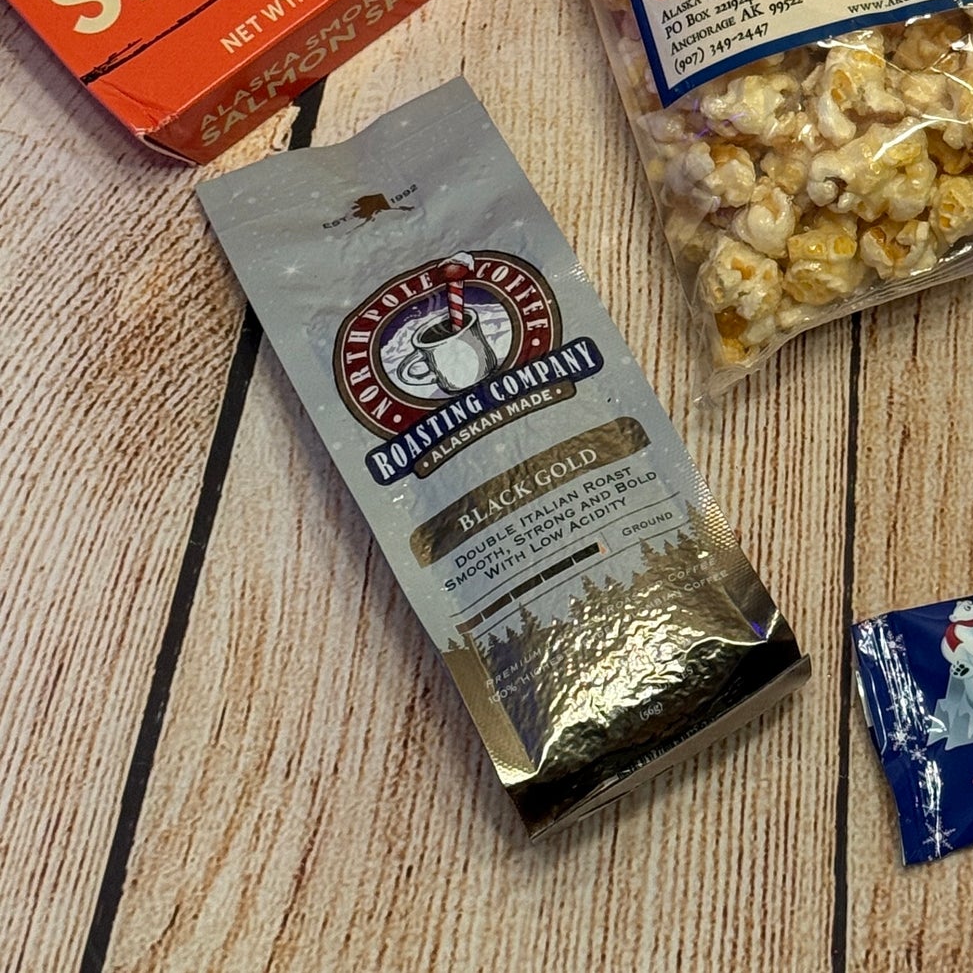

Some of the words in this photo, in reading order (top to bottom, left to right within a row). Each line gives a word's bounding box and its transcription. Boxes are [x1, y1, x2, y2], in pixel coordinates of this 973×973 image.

[219, 16, 264, 54] NET
[665, 21, 682, 39] PO
[670, 17, 736, 56] ANCHORAGE
[740, 3, 765, 22] AK
[674, 47, 705, 75] (907)
[710, 22, 769, 57] 349-2447
[201, 51, 301, 129] ALASKA
[202, 25, 357, 147] SALMON
[362, 272, 433, 322] POLE
[476, 261, 549, 332] COFFEE
[347, 328, 393, 420] NORTH
[371, 393, 483, 480] ROASTING
[489, 340, 597, 402] COMPANY
[431, 410, 503, 463] ALASKAN
[506, 389, 553, 414] MADE
[454, 524, 516, 569] DOUBLE
[519, 490, 579, 528] ITALIAN
[583, 466, 634, 494] ROAST
[458, 480, 533, 533] BLACK
[534, 447, 598, 487] GOLD
[622, 510, 674, 537] GROUND
[444, 546, 512, 593] SMOOTH,
[513, 508, 576, 547] STRONG
[580, 491, 612, 511] AND
[615, 470, 658, 495] BOLD
[484, 550, 527, 581] WITH
[532, 530, 565, 554] LOW
[570, 497, 628, 535] ACIDITY
[486, 647, 541, 694] PREMIUM
